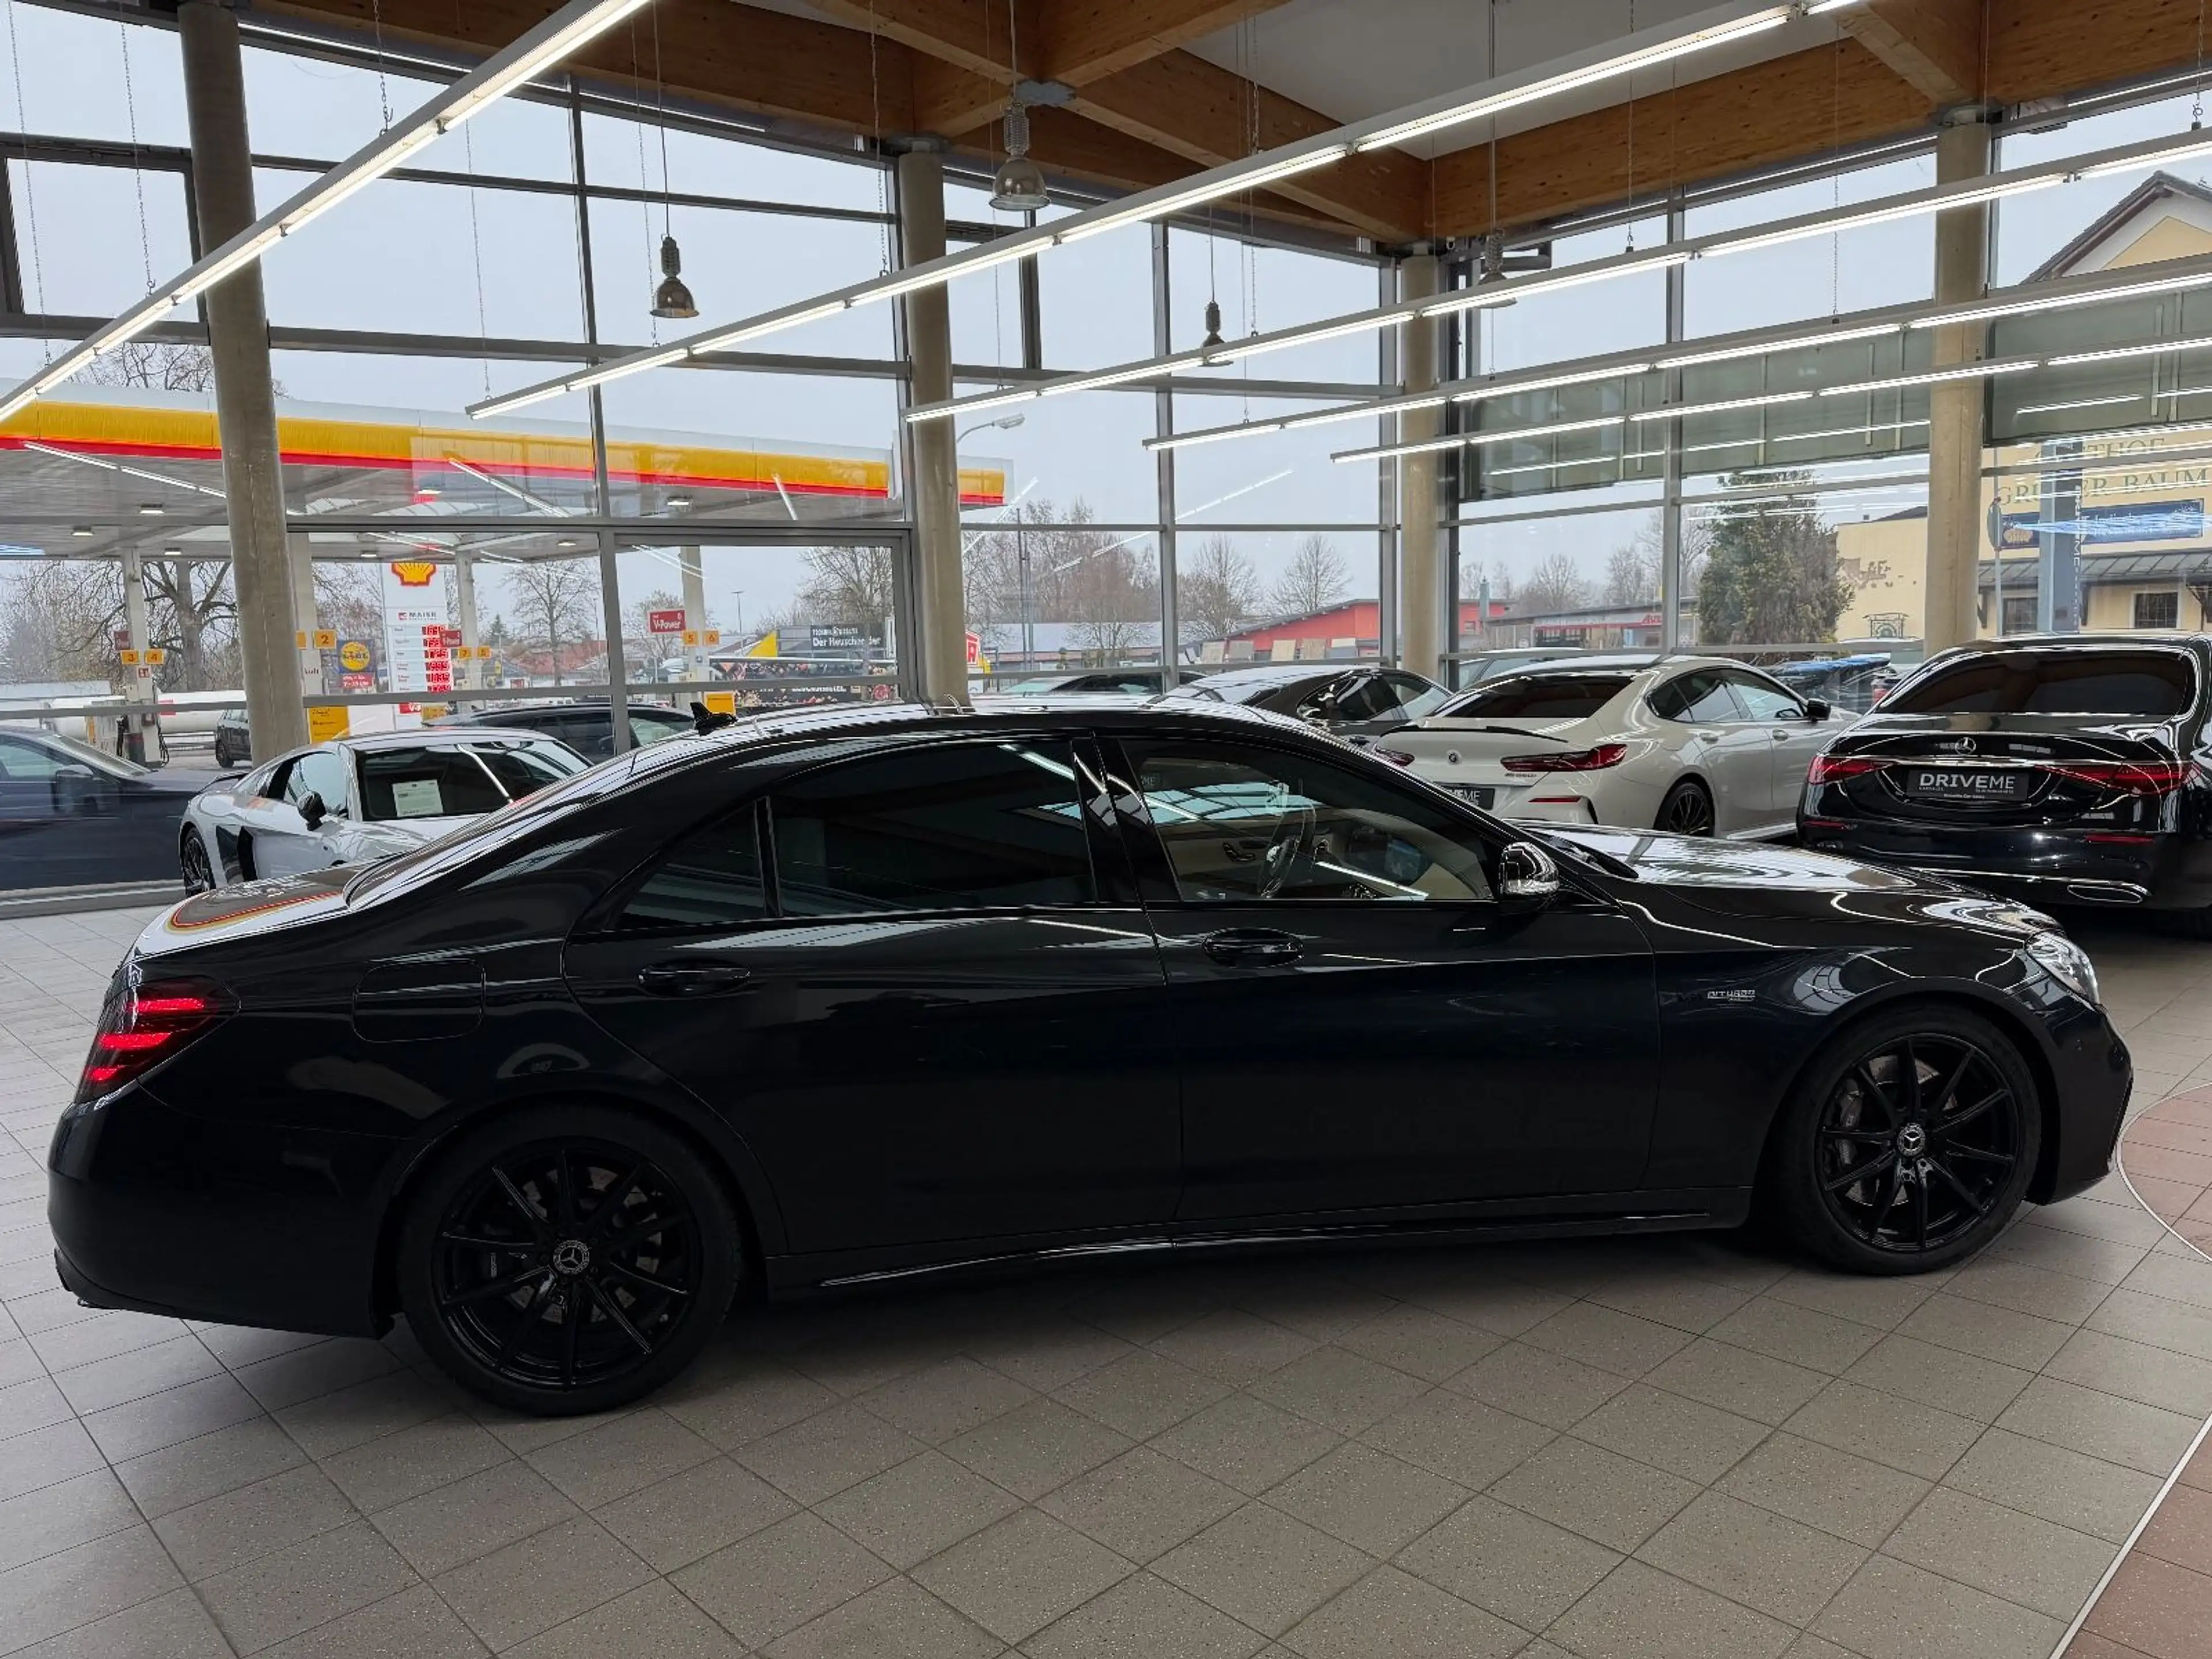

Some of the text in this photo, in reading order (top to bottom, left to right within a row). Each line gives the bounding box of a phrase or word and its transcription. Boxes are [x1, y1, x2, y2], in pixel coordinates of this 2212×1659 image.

[321, 634, 329, 645] 2
[688, 634, 694, 643] 5
[1919, 773, 2016, 790] DRIVEME
